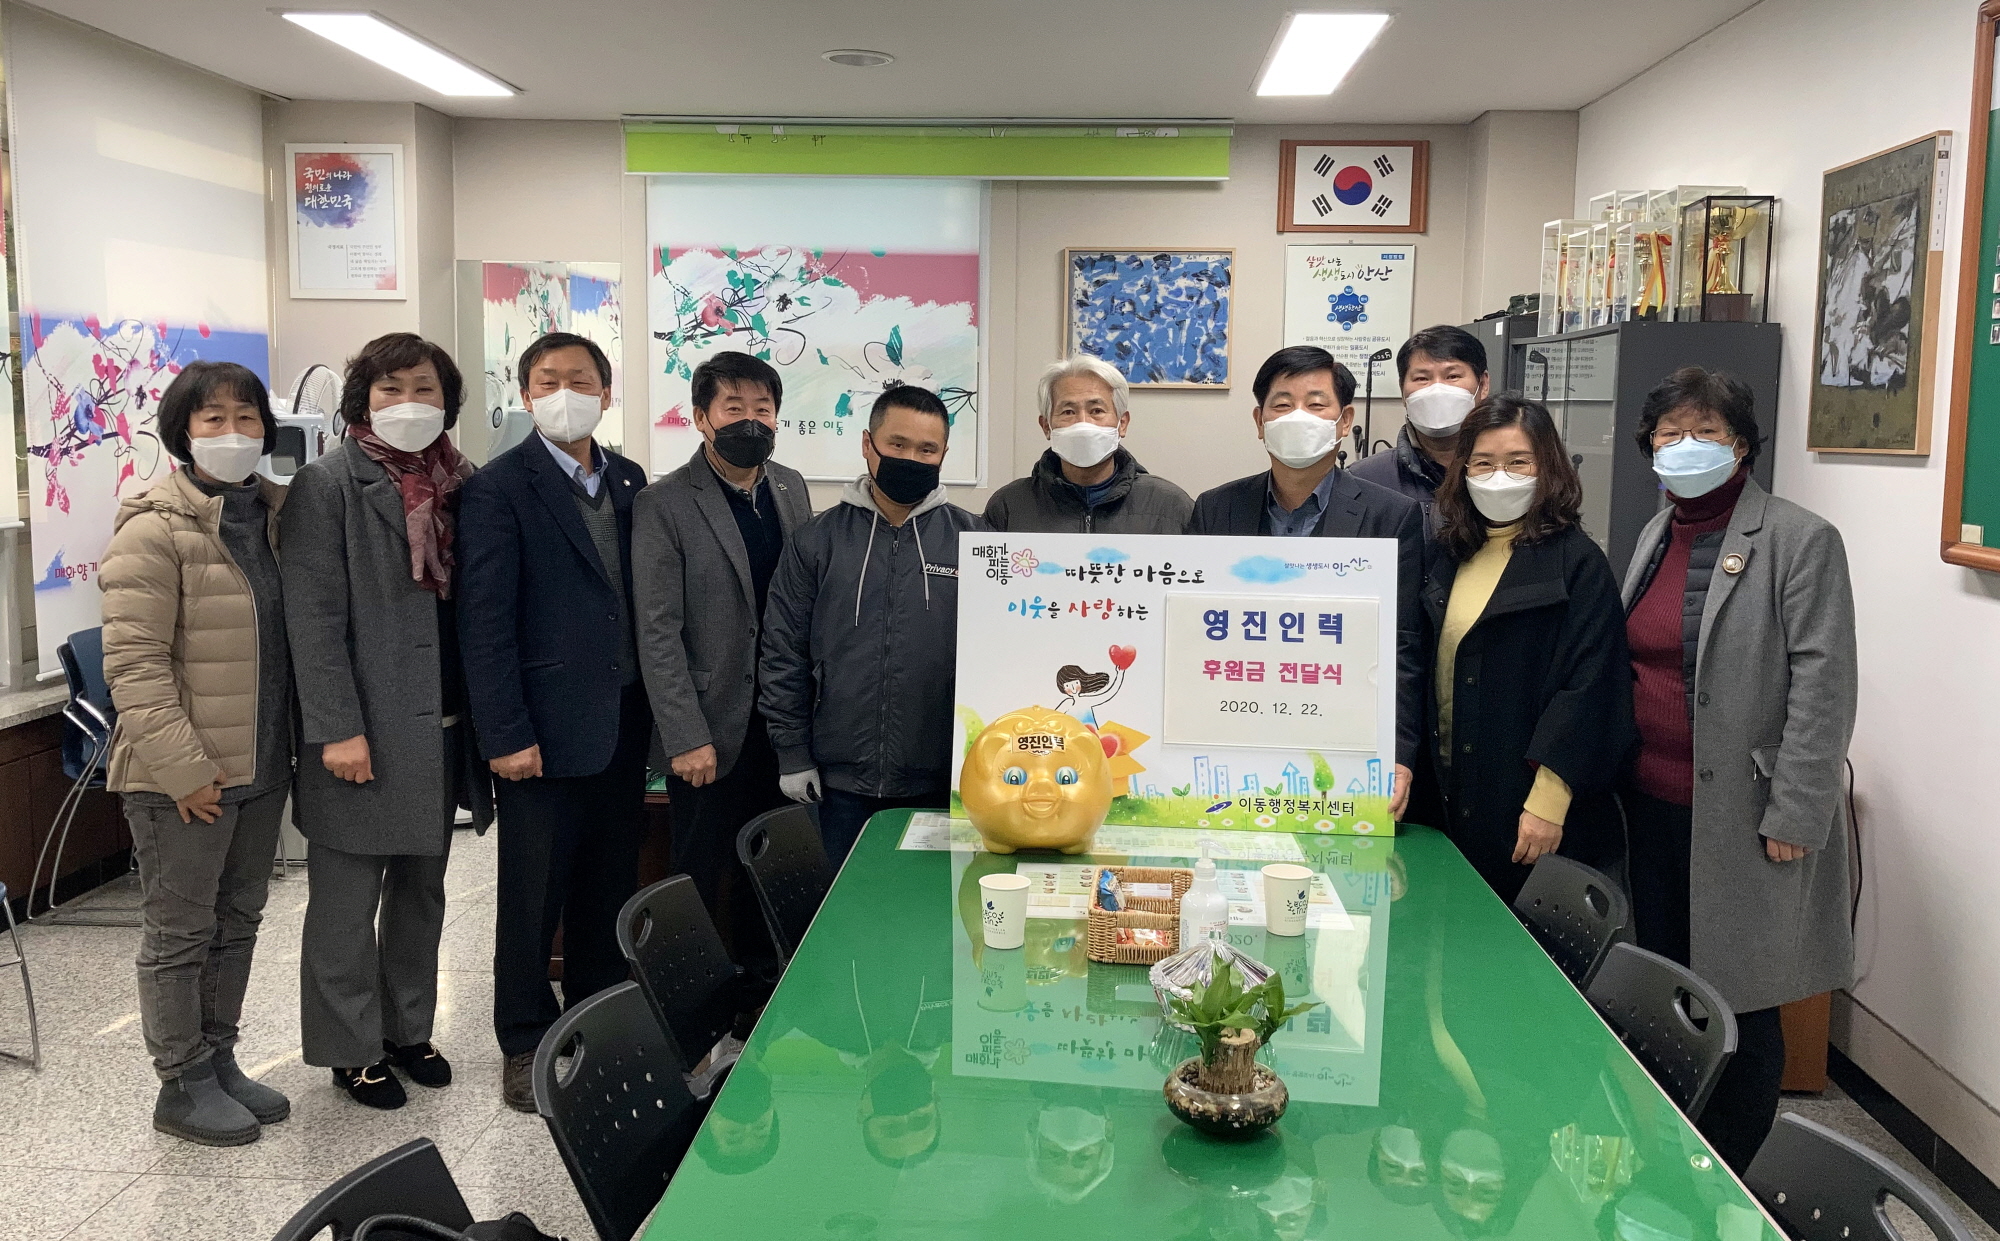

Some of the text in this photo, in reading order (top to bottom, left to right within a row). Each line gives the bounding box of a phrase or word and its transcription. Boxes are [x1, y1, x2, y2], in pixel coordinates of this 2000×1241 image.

[303, 167, 352, 182] 국민의 나라
[304, 183, 332, 194] 정의로운
[304, 194, 353, 211] 대한민국
[1313, 265, 1393, 282] 생생도시 안산
[798, 420, 816, 436] 좋은
[823, 421, 844, 436] 이동
[972, 543, 1009, 558] 매화가
[54, 561, 98, 581] 매화향기
[925, 563, 956, 575] Privacy
[988, 557, 1010, 568] 피는
[986, 568, 1013, 586] 이동
[1065, 562, 1205, 585] 따뜻한 마음으로
[1007, 595, 1149, 621] 이웃을 사랑하는
[1202, 659, 1342, 686] 후원금 전달식
[1220, 700, 1323, 717] 2020. 12. 22.
[1017, 735, 1065, 751] 영진인력
[1238, 797, 1354, 817] 이동행정복지센터
